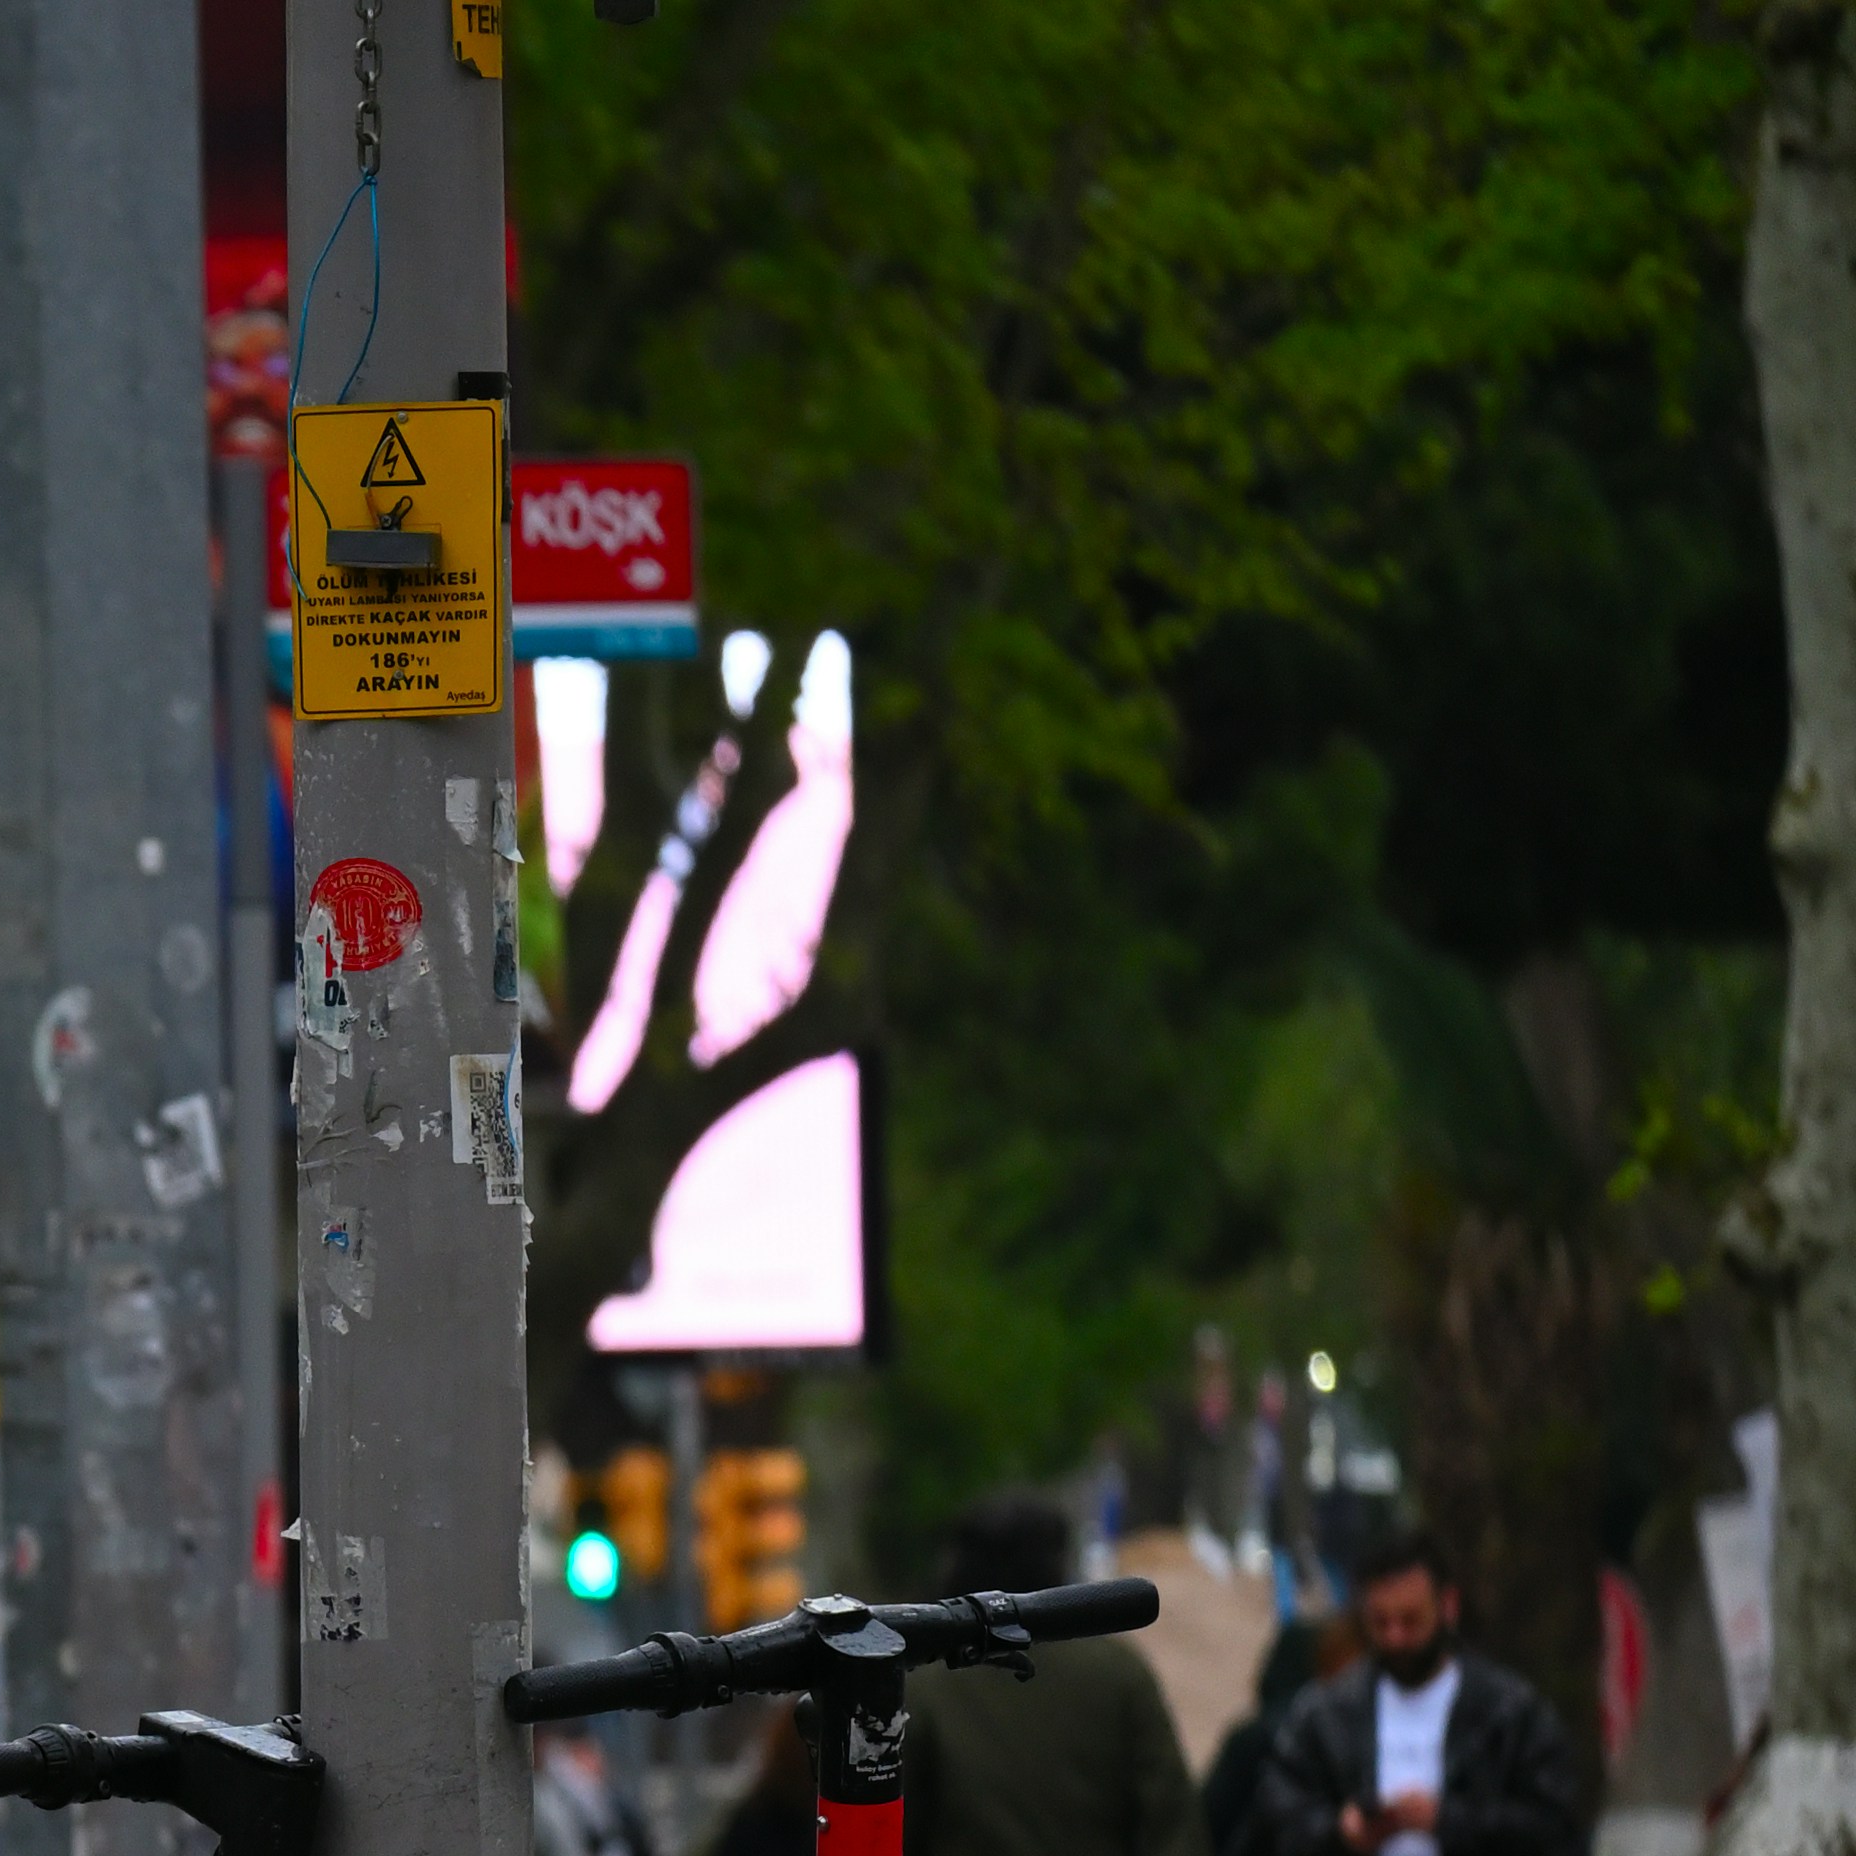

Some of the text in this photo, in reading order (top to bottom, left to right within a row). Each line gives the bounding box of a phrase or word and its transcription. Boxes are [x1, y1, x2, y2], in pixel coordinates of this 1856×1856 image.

[317, 568, 477, 590] ÖLÜM THLİKESİ
[308, 597, 345, 607] UYARI
[411, 591, 485, 604] YANIYORSA
[306, 609, 488, 626] DİREKTE KAÇAK VARDIR
[333, 630, 461, 647] DOKUNMAYIN
[356, 674, 440, 692] ARAYIN
[446, 690, 486, 703] Ayedaş
